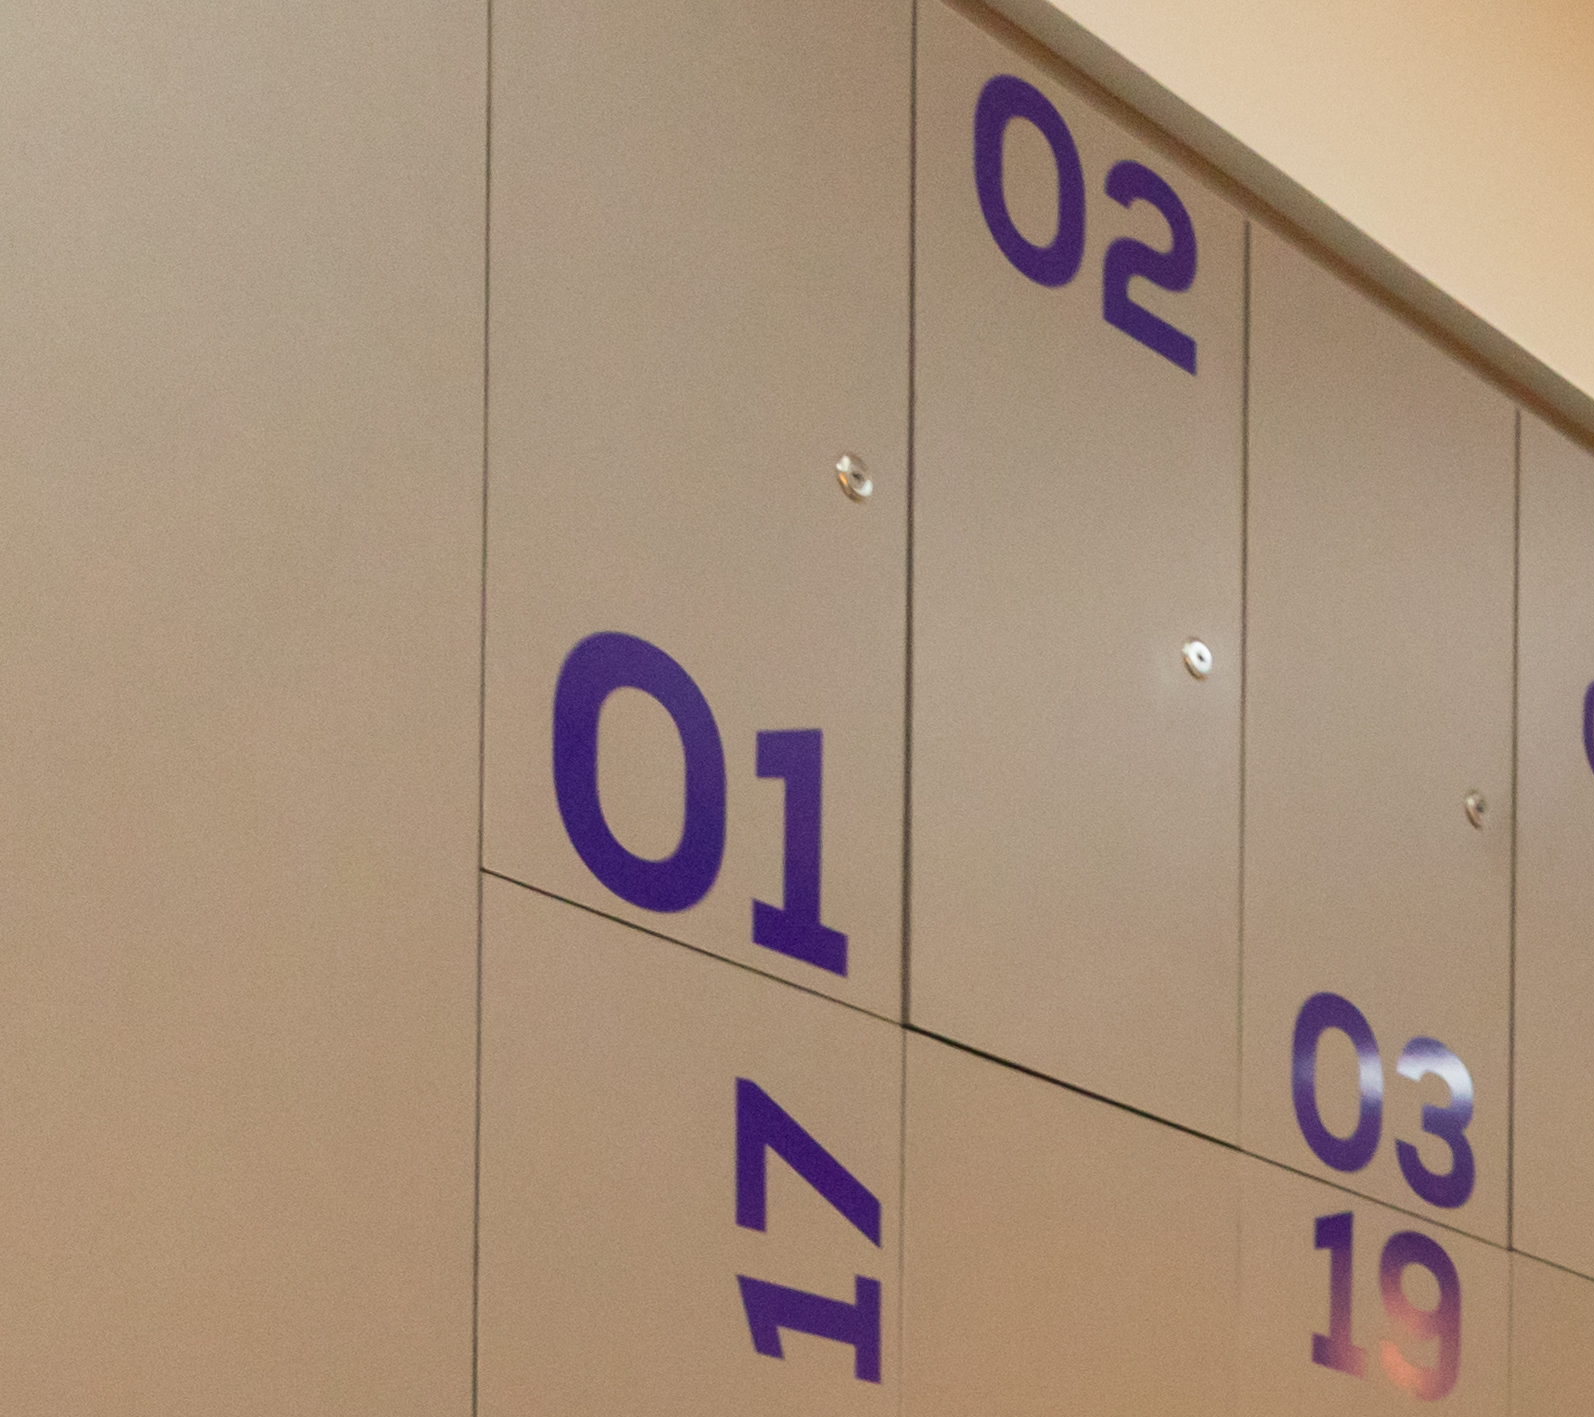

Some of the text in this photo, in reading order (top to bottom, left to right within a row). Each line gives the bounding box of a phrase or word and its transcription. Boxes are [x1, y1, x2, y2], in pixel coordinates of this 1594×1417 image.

[973, 74, 1197, 375] 02
[552, 631, 849, 977] 01
[734, 1077, 882, 1384] 17
[1291, 992, 1475, 1209] 03
[1311, 1210, 1463, 1400] 19
